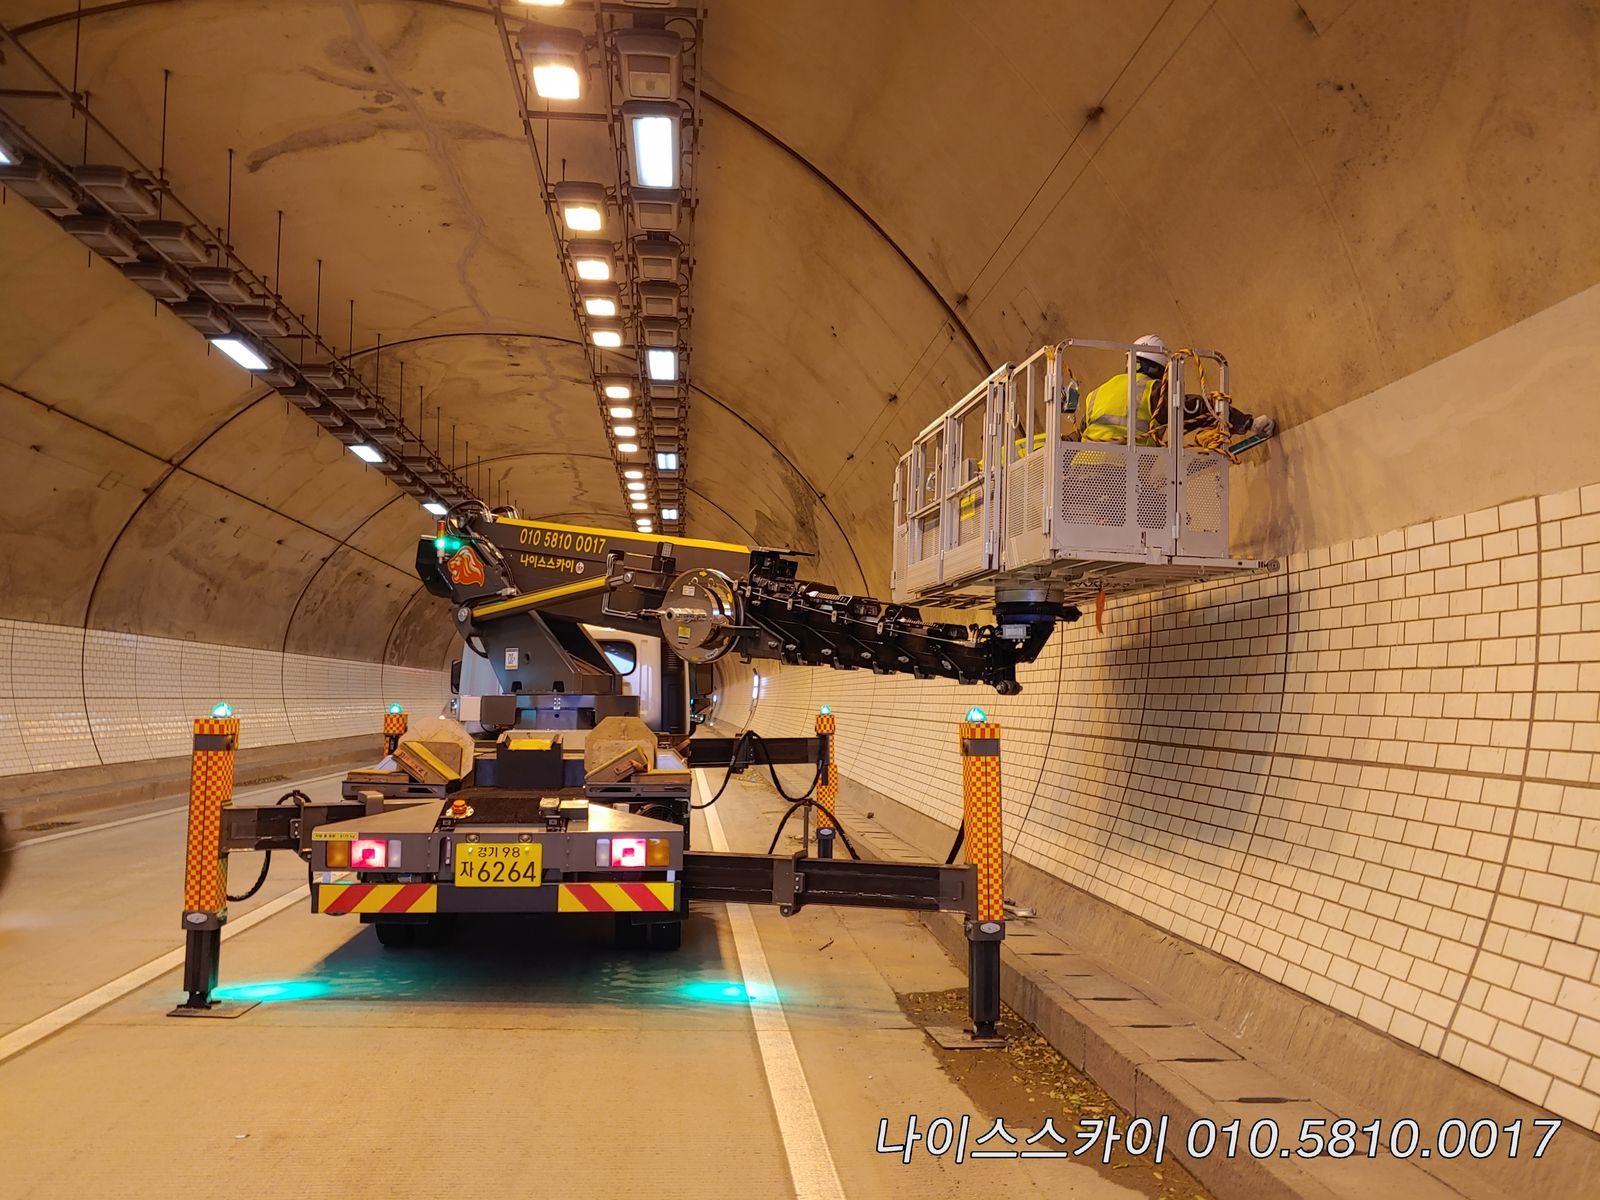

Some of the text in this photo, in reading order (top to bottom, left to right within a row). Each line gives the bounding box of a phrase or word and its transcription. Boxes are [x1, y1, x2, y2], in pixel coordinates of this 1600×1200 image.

[520, 528, 607, 554] 010 5810 0017
[520, 553, 575, 573] 나이스스카이
[478, 847, 521, 858] 경기 98
